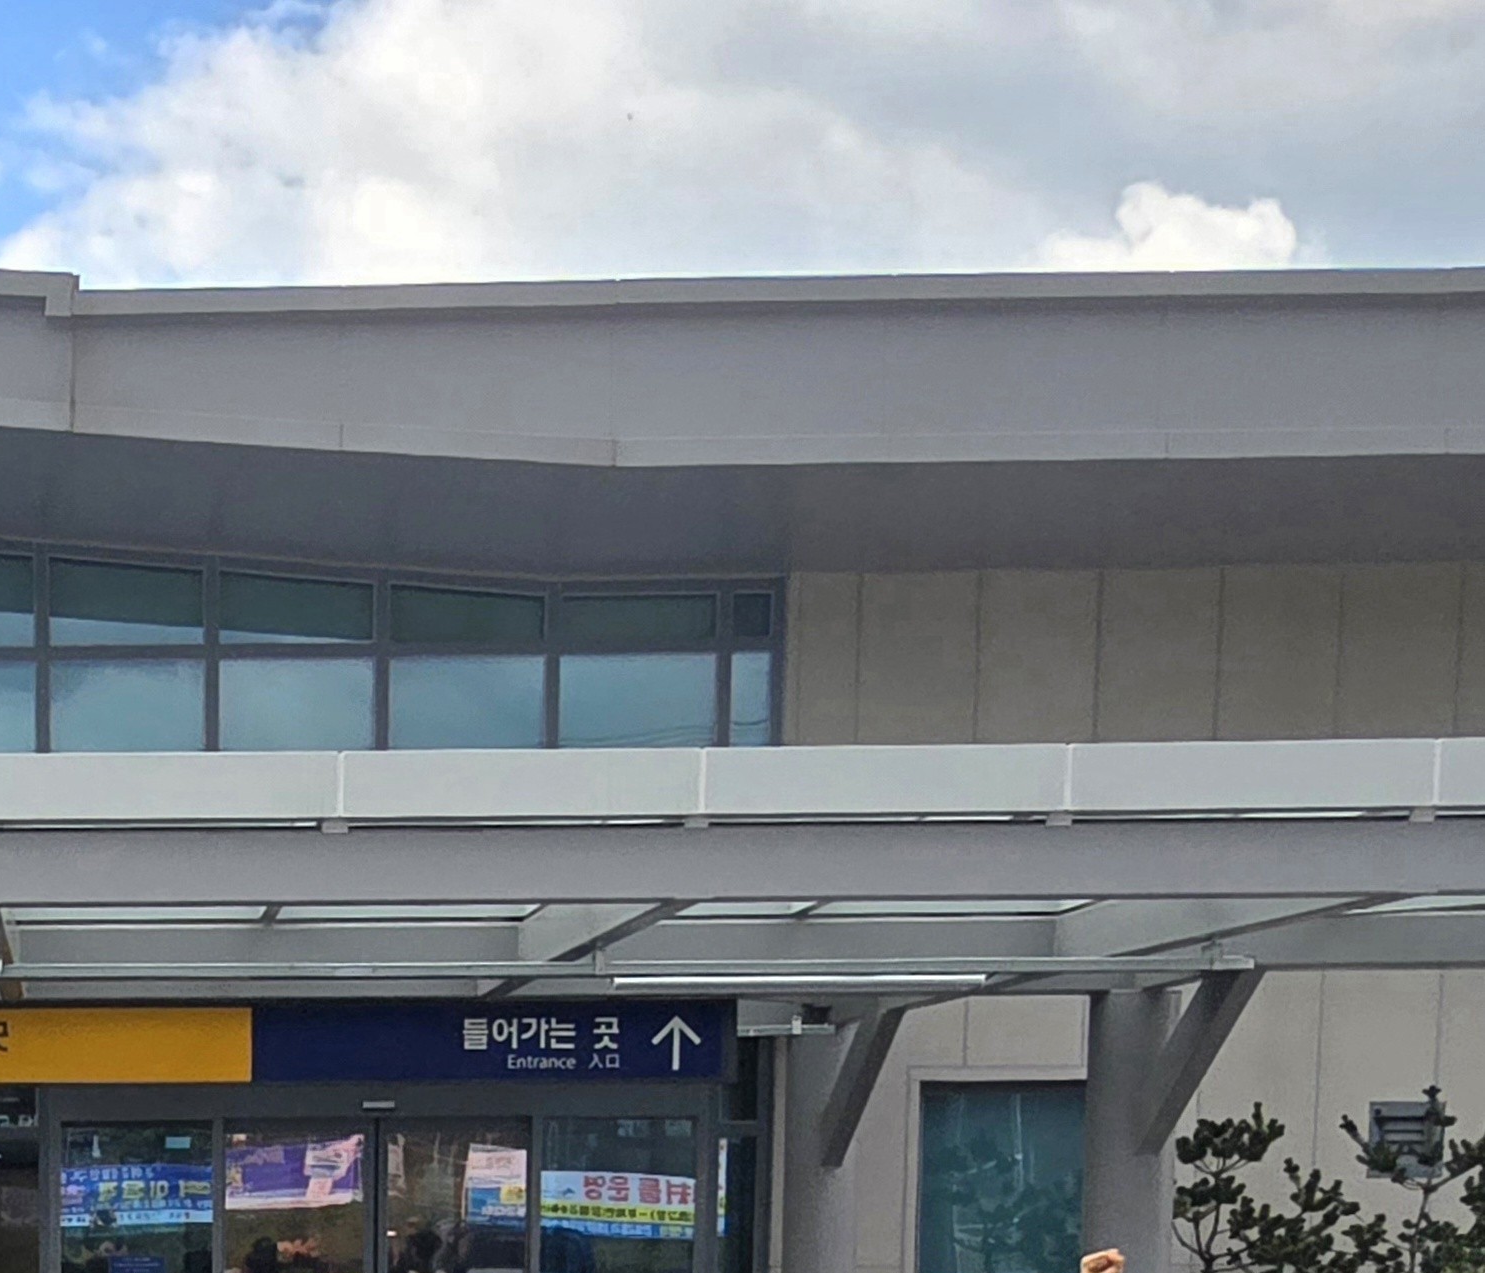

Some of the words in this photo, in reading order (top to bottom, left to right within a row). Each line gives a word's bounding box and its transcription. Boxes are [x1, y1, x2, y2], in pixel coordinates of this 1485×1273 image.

[463, 1017, 576, 1050] 들어가는
[593, 1017, 620, 1050] 곳
[507, 1054, 577, 1069] Entrance
[588, 1053, 620, 1069] 入口
